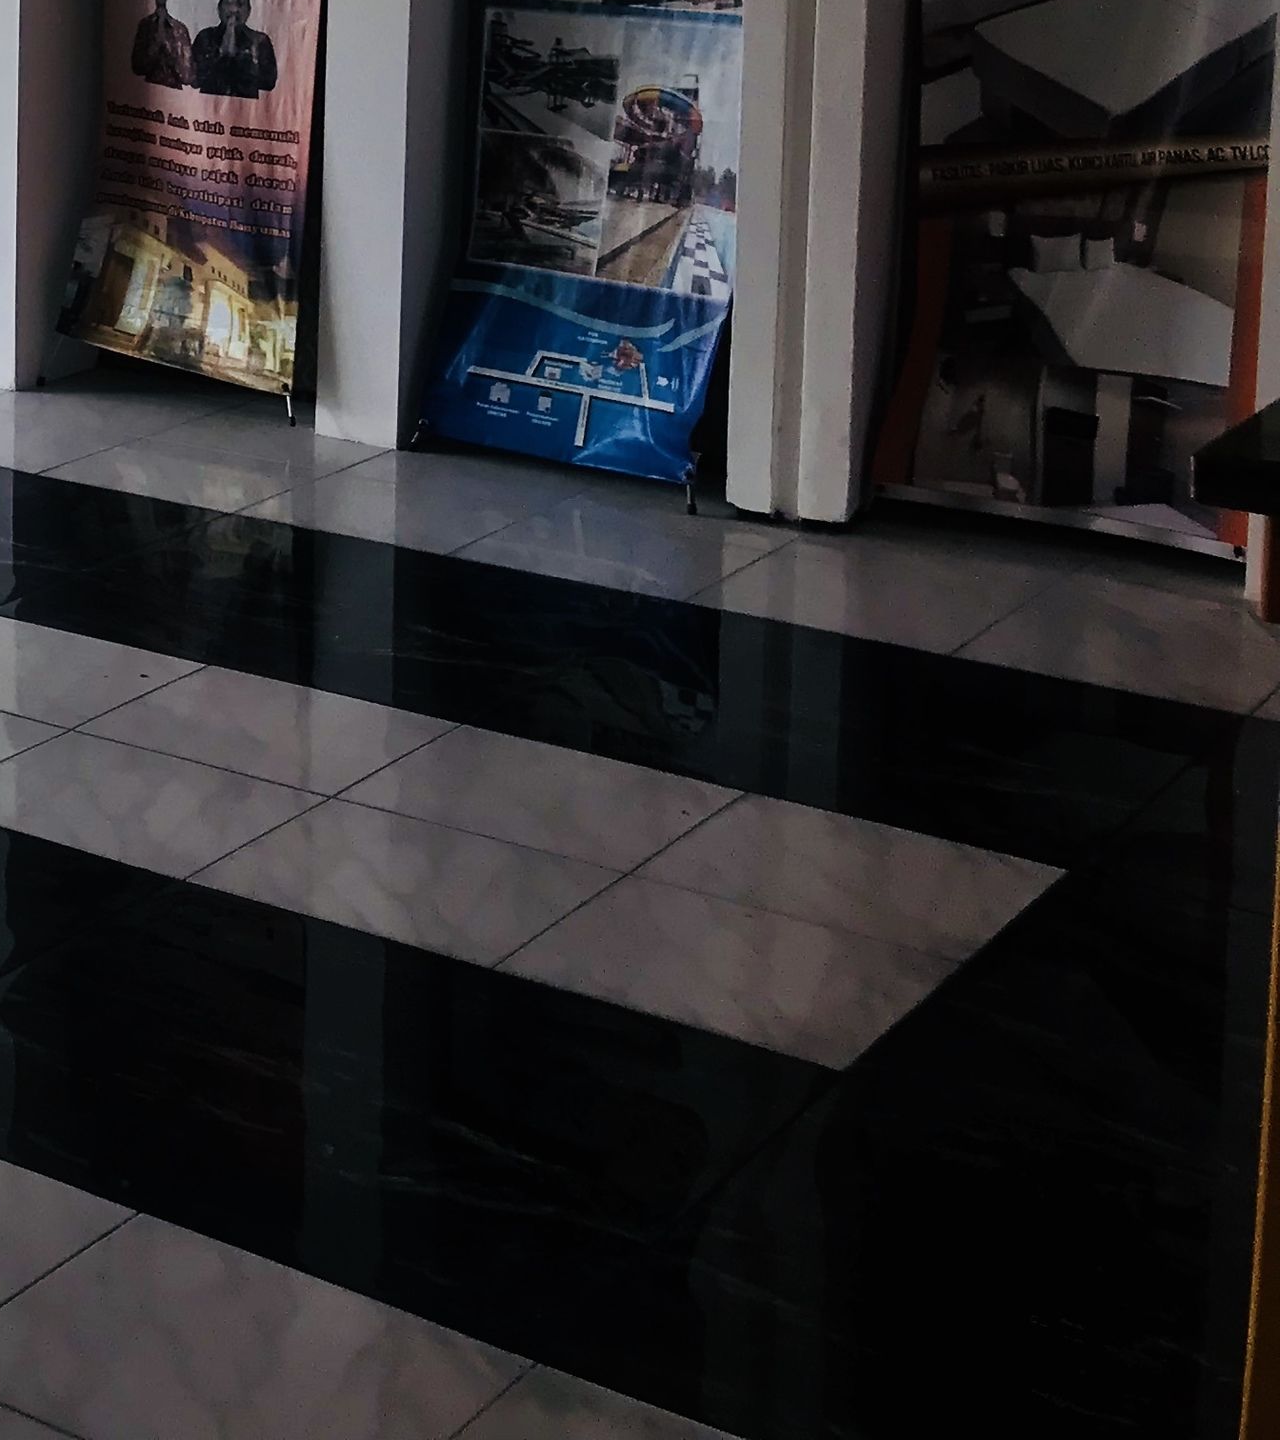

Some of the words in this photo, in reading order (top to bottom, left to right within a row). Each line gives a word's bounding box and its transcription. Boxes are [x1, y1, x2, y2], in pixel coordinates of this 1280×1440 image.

[193, 120, 225, 136] telah
[230, 126, 300, 145] memenuhi
[207, 146, 244, 162] pajak
[202, 168, 239, 185] pajak
[246, 173, 296, 192] daerah
[251, 199, 294, 216] dalam
